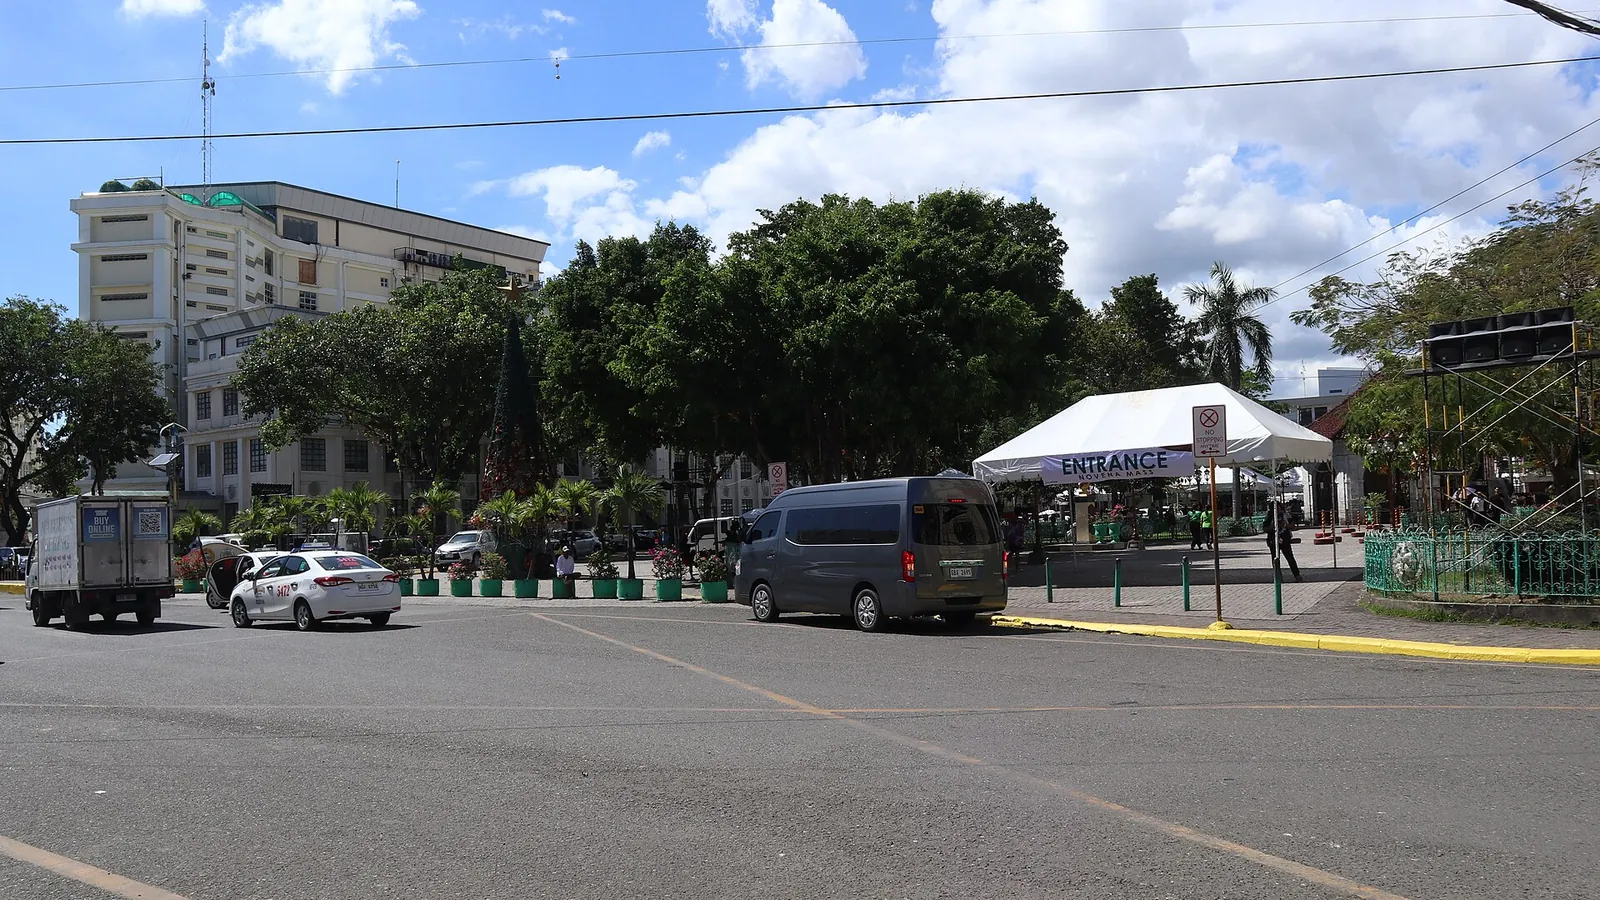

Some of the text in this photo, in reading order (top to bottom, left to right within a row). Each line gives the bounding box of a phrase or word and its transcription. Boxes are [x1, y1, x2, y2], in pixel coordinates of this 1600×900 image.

[1062, 451, 1168, 476] ENTRANCE
[1078, 471, 1121, 480] NOVENA
[94, 516, 109, 525] BUY
[88, 525, 115, 534] ONLINE
[276, 584, 290, 597] 5472
